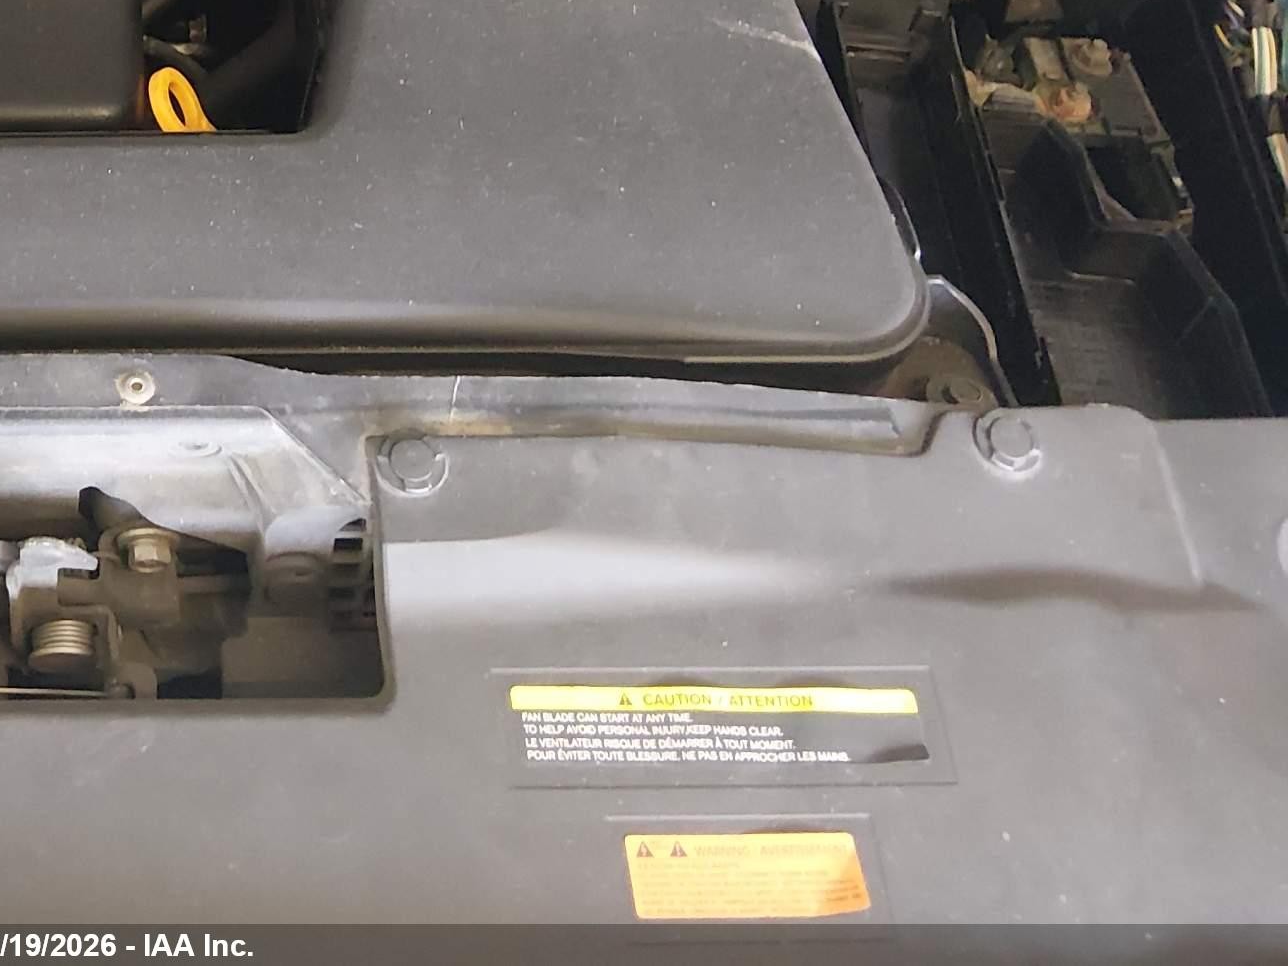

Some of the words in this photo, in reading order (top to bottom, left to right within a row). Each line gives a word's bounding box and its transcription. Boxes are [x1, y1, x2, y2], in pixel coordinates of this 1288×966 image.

[642, 693, 712, 706] CAUTION
[728, 695, 814, 707] ATTENTION
[521, 712, 542, 723] FAN
[542, 712, 576, 723] BLADE
[576, 712, 598, 723] CAN
[599, 713, 630, 723] START
[631, 713, 644, 723] AT
[645, 713, 666, 723] ANY
[667, 713, 694, 723] TIME.
[523, 724, 538, 735] TO
[539, 724, 565, 735] HELP
[566, 725, 597, 735] AVOID
[597, 725, 652, 736] PERSONAL
[713, 726, 748, 737] HANDS
[748, 726, 784, 737] CLEAR.
[525, 738, 538, 748] LE
[539, 738, 603, 748] VENTILATEUR
[604, 738, 642, 749] RISQUE
[643, 739, 657, 749] DE
[658, 737, 714, 749] DÉMARRER
[724, 739, 749, 749] TOUT
[750, 739, 797, 749] MOMENT.
[527, 750, 556, 761] POUR
[557, 749, 591, 761] ÉVITER
[592, 751, 624, 761] TOUTE
[682, 751, 697, 761] NE
[698, 751, 718, 762] PAS
[719, 751, 734, 762] EN
[734, 751, 797, 763] APPROCHER
[798, 751, 817, 762] LES
